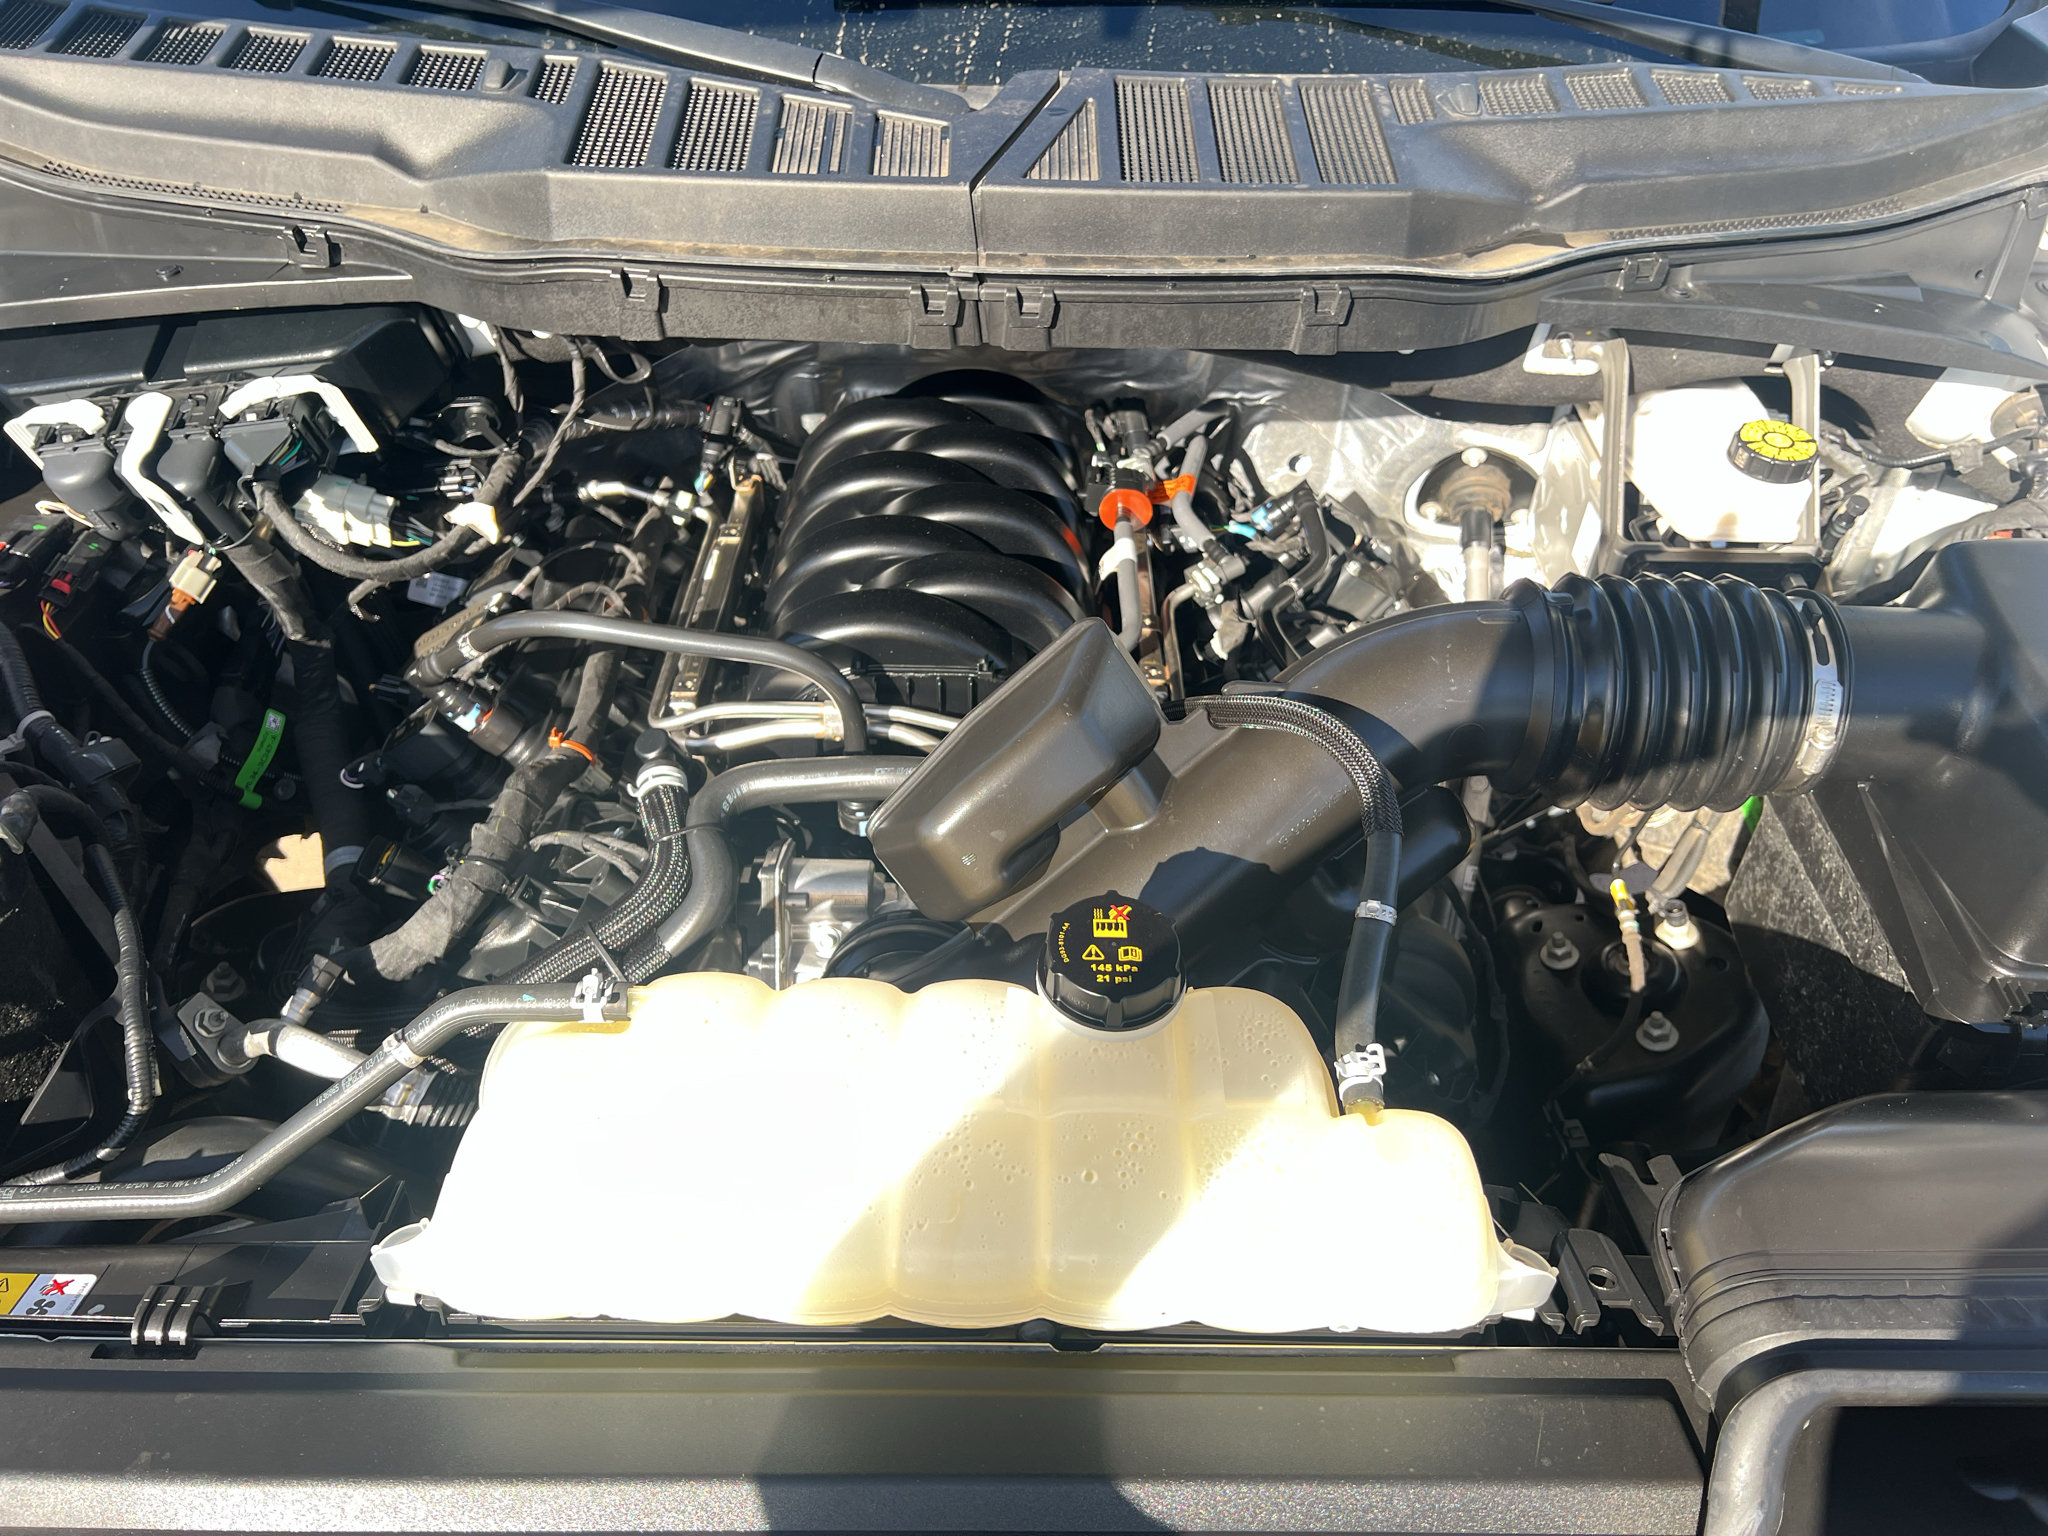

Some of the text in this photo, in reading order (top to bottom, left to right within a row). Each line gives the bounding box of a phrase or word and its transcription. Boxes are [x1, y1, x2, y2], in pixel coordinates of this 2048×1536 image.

[1090, 963, 1139, 973] 145 kPa
[1096, 974, 1132, 984] 21 psi
